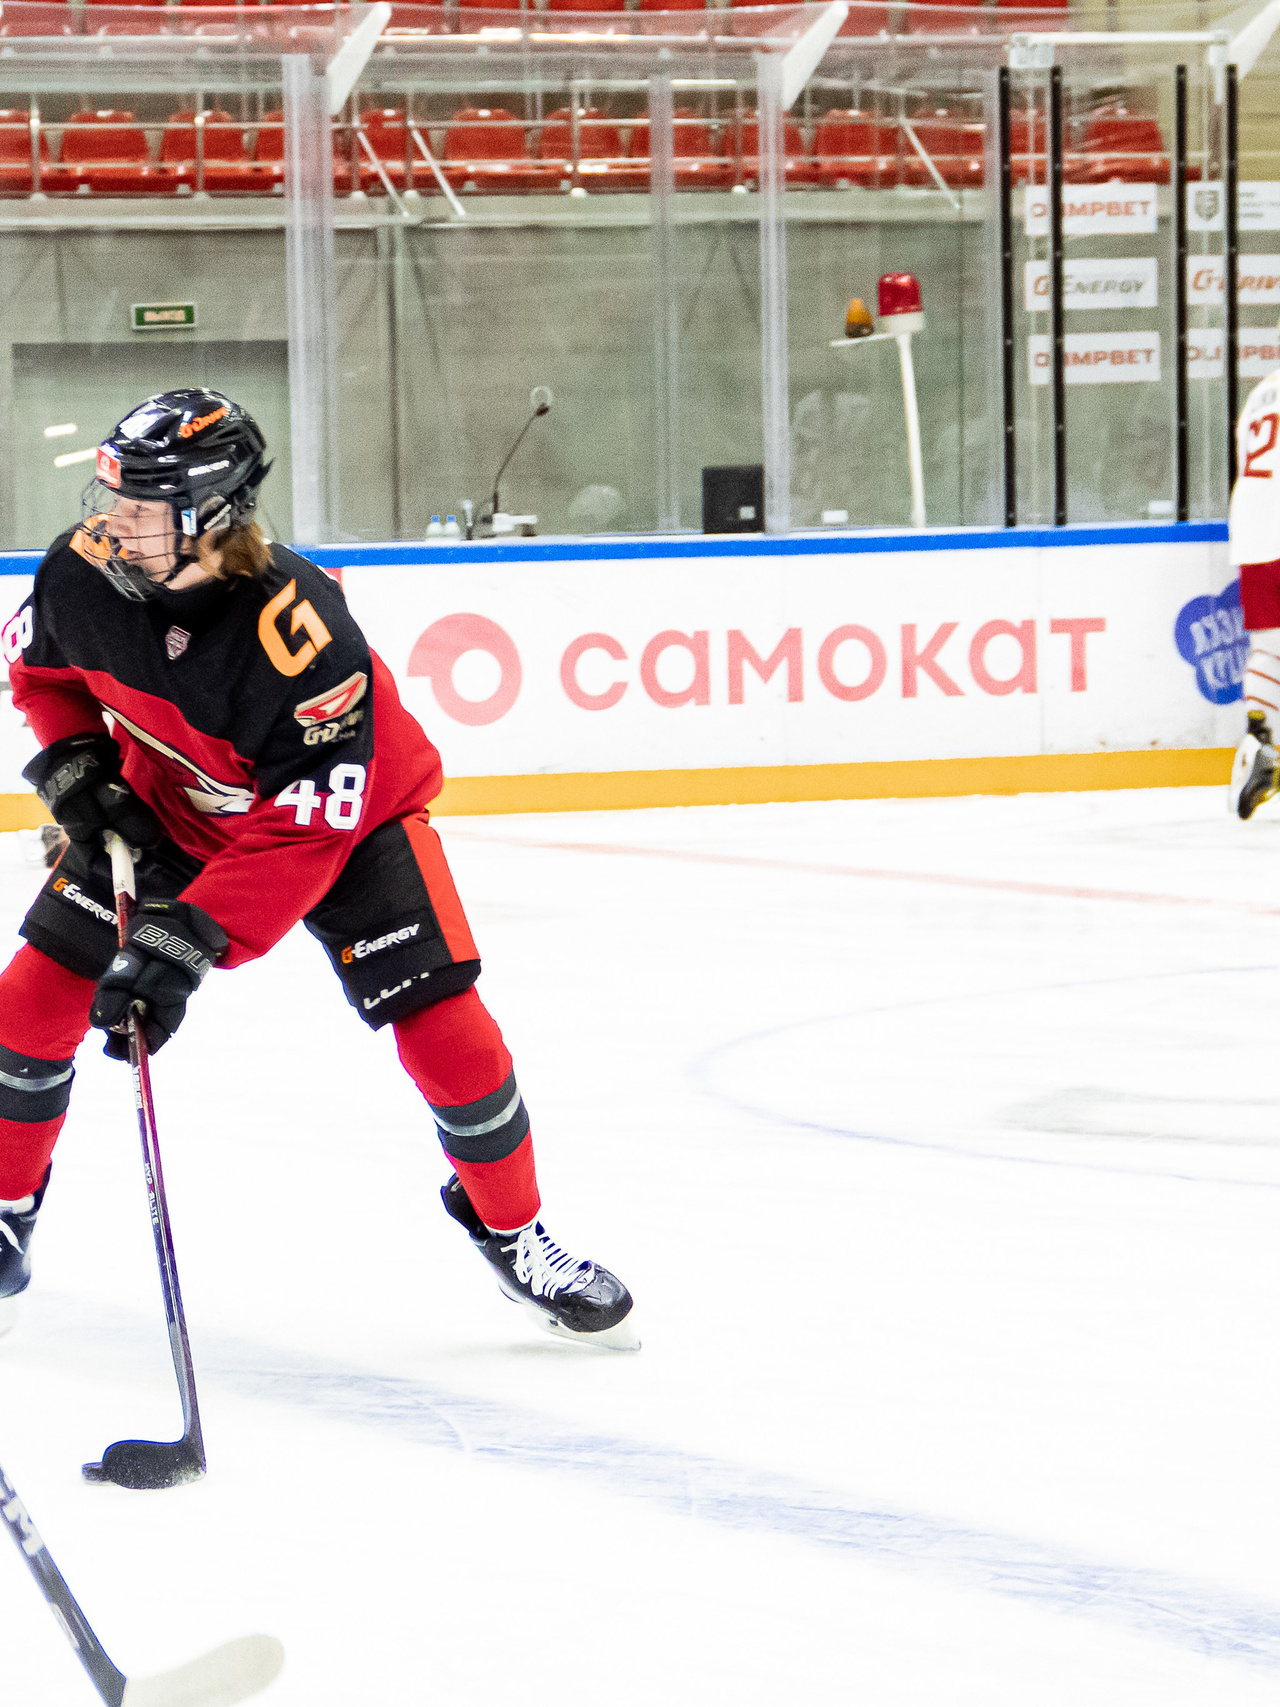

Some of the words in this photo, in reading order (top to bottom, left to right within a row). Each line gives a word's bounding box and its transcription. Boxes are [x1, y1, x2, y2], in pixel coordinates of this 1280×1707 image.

[1034, 348, 1154, 367] OIMPBET
[274, 763, 367, 830] 48
[341, 923, 420, 964] G-ENERGY
